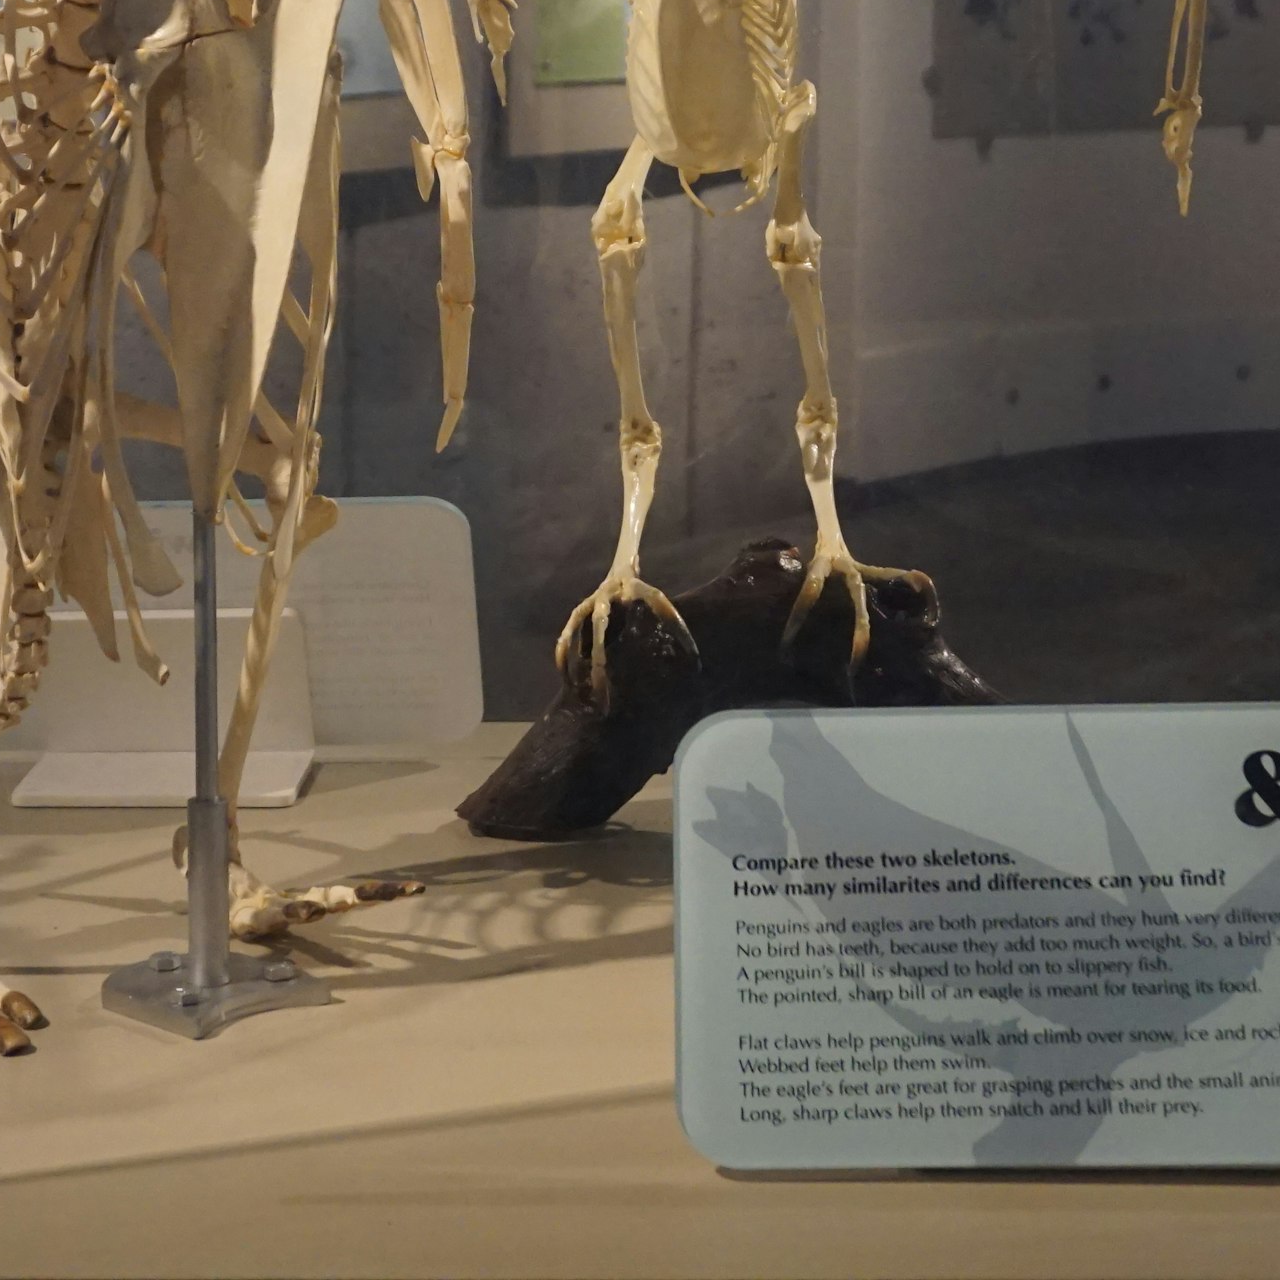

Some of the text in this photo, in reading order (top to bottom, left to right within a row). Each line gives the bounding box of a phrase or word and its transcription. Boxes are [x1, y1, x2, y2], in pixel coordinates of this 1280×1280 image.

[732, 848, 1016, 875] Compare these two skeletons.
[733, 868, 1227, 900] How many similarites and differences can you find?
[736, 919, 810, 938] Penguins
[815, 917, 846, 934] and
[852, 917, 904, 937] eagles
[909, 920, 935, 932] are
[939, 915, 977, 931] both
[982, 913, 1059, 934] predators
[1064, 911, 1096, 928] and
[1100, 911, 1136, 932] they
[1141, 909, 1180, 927] hunt
[1185, 913, 1220, 930] very
[736, 943, 762, 958] No
[767, 940, 800, 957] bird
[806, 939, 835, 956] has
[839, 939, 885, 957] teeth,
[890, 937, 958, 956] because
[962, 936, 999, 959] they
[1004, 934, 1035, 952] add
[1040, 934, 1068, 951] too
[1072, 931, 1121, 950] much
[1223, 934, 1233, 947] a
[737, 966, 749, 981] A
[754, 964, 834, 984] penguin's
[838, 962, 865, 978] bill
[872, 963, 884, 977] is
[888, 960, 949, 981] shaped
[953, 961, 970, 976] to
[975, 959, 1014, 976] hold
[1019, 961, 1040, 975] on
[1045, 959, 1062, 974] to
[1067, 957, 1133, 979] slippery
[738, 975, 1262, 1007] The pointed, sharp bill of an eagle is meant for tearing its food.
[738, 1034, 768, 1050] Flat
[774, 1033, 822, 1049] claws
[827, 1032, 864, 1052] help
[870, 1031, 946, 1052] penguins
[950, 1029, 991, 1046] walk
[996, 1028, 1028, 1045] and
[1033, 1027, 1082, 1045] climb
[1087, 1031, 1124, 1043] over
[1183, 1026, 1209, 1040] ice
[1214, 1024, 1246, 1040] and
[738, 1057, 809, 1074] Webbed
[815, 1056, 845, 1072] feet
[851, 1055, 888, 1075] help
[893, 1055, 935, 1071] them
[739, 1081, 771, 1098] The
[776, 1080, 834, 1101] eagle's
[838, 1079, 869, 1096] feet
[875, 1083, 901, 1095] are
[907, 1079, 948, 1099] great
[953, 1077, 976, 1094] for
[982, 1076, 1054, 1098] grasping
[1058, 1074, 1125, 1095] perches
[1129, 1073, 1162, 1090] and
[1166, 1073, 1193, 1089] the
[1199, 1071, 1244, 1088] small
[792, 1104, 838, 1124] sharp
[843, 1103, 893, 1120] claws
[897, 1102, 935, 1122] help
[940, 1101, 984, 1118] them
[988, 1099, 1044, 1118] snatch
[1049, 1098, 1082, 1116] and
[1087, 1097, 1113, 1115] kill
[1118, 1098, 1157, 1114] their
[1163, 1100, 1204, 1121] prey.
